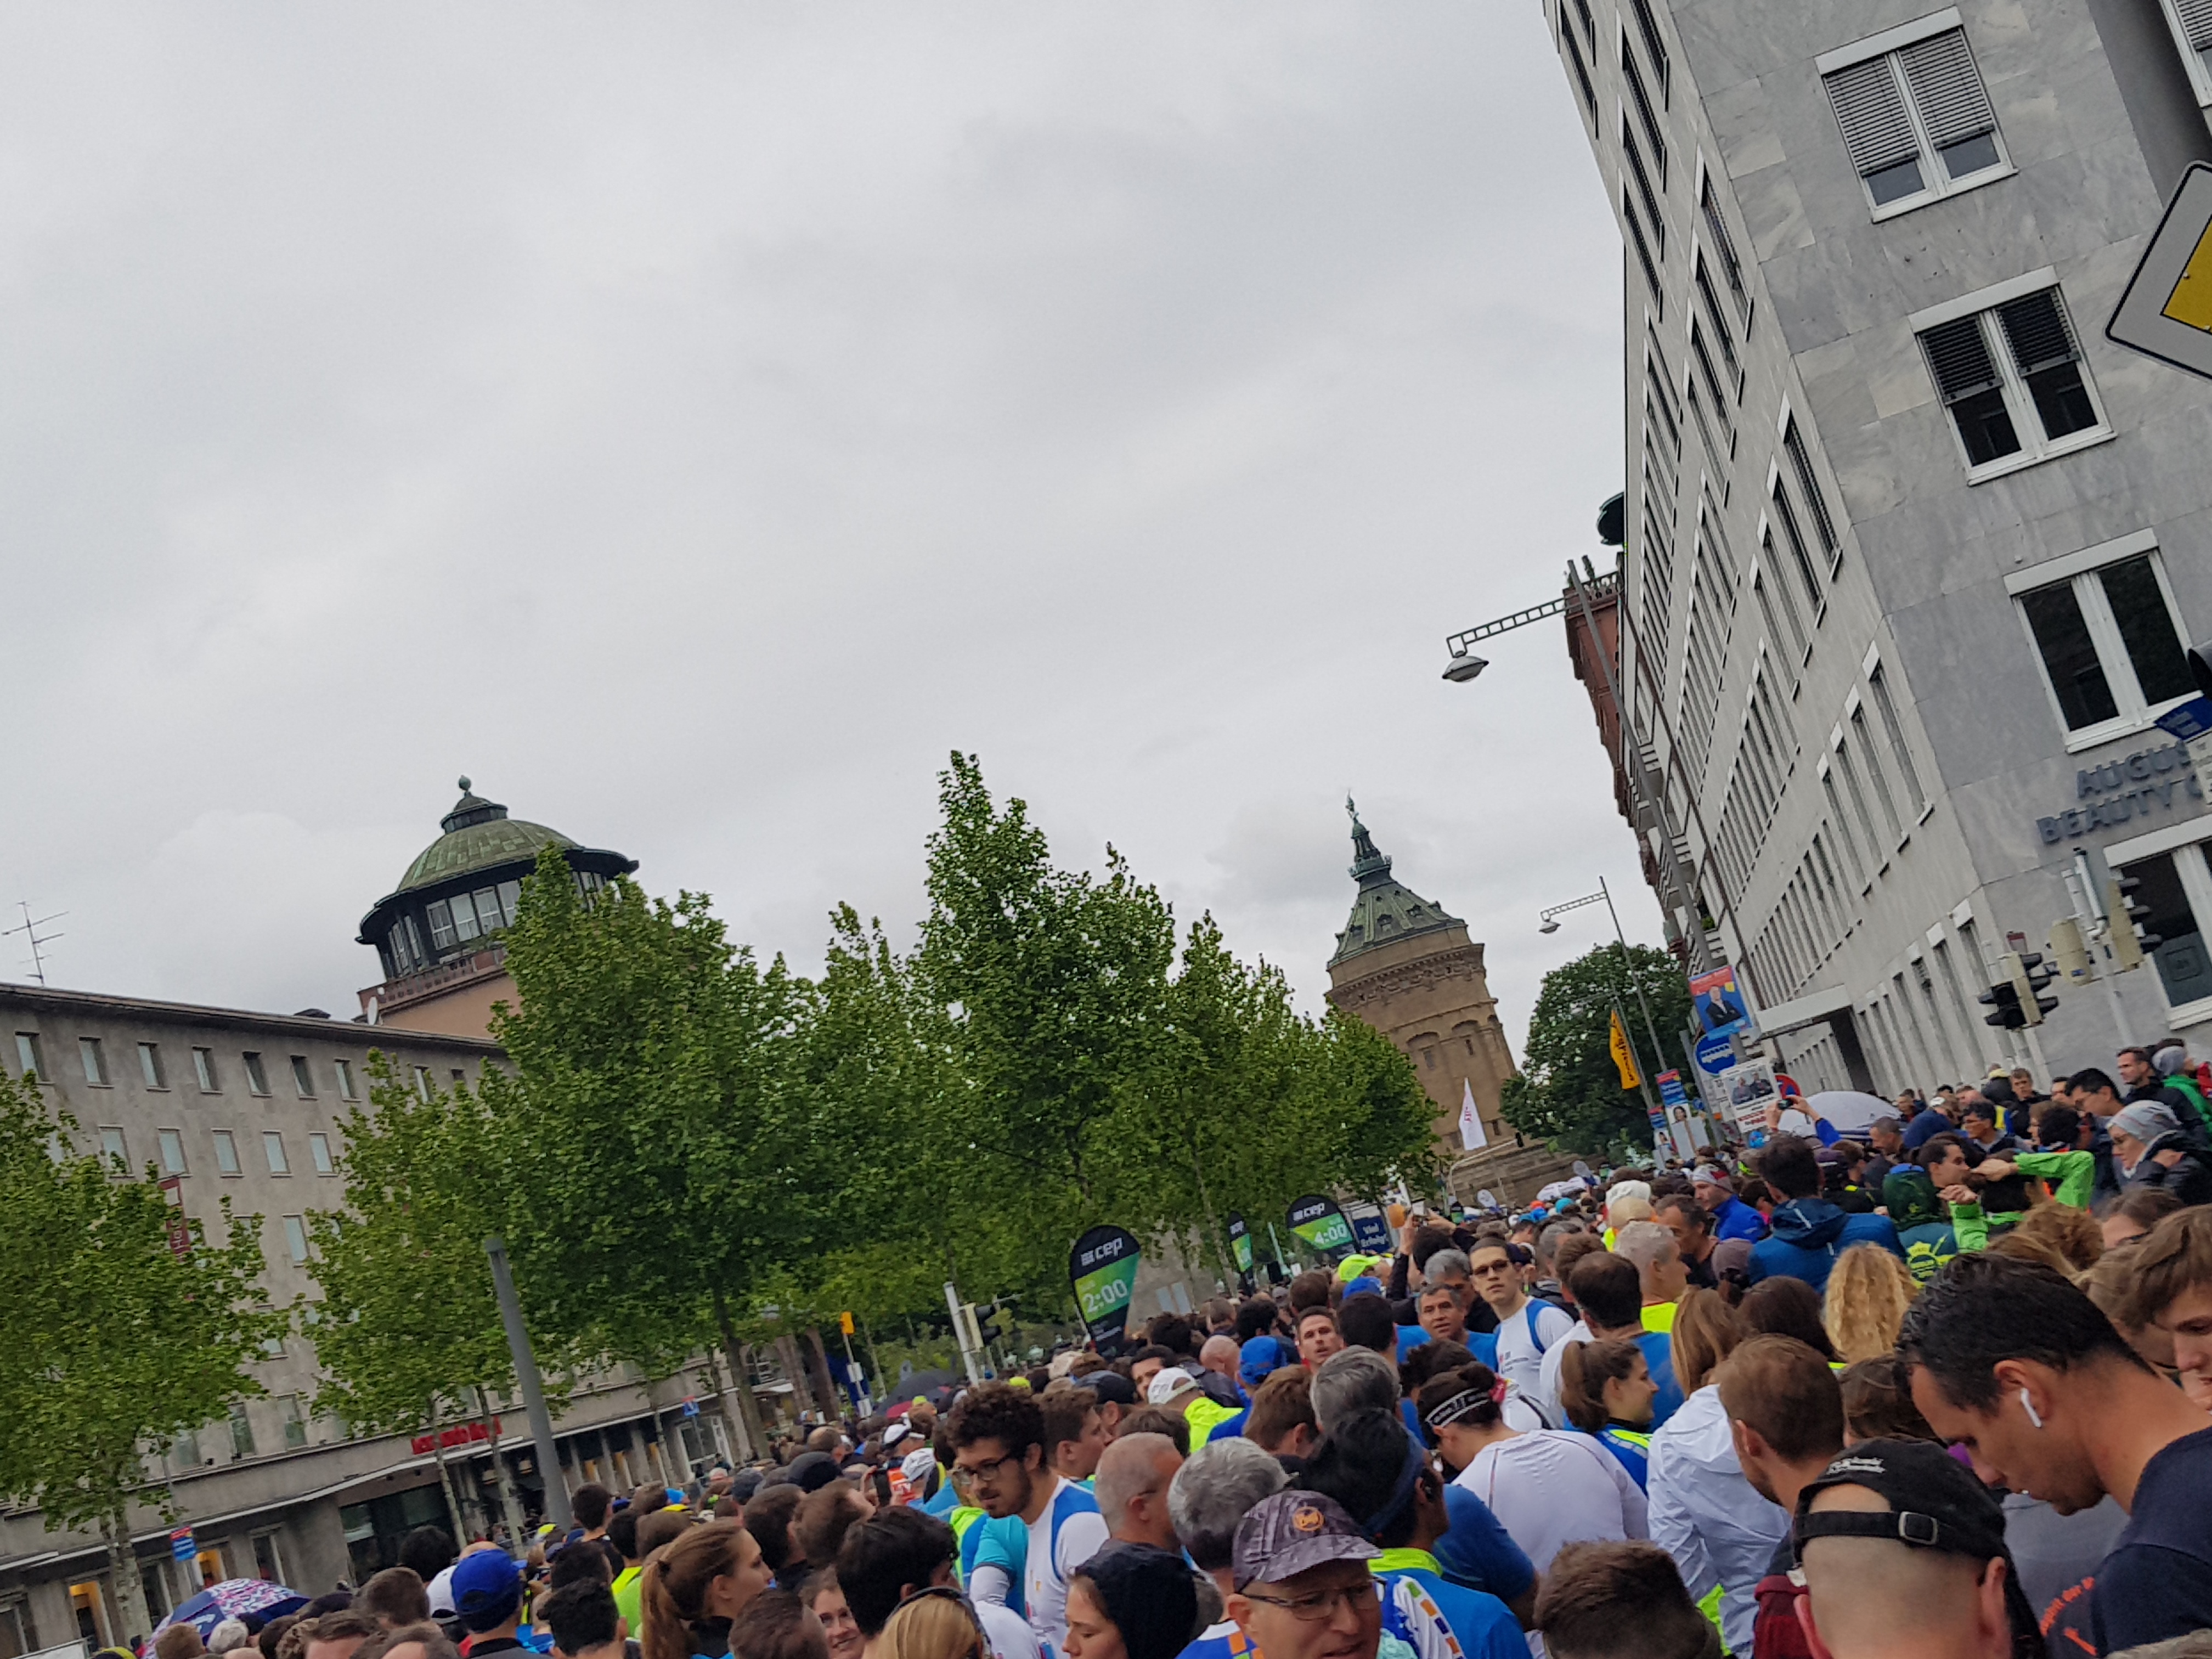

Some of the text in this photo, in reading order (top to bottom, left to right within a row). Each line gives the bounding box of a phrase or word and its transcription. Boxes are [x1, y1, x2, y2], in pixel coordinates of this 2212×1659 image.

[2036, 779, 2174, 844] BEAUTY
[1314, 1223, 1347, 1244] 4:00
[1083, 1279, 1128, 1313] 2:00
